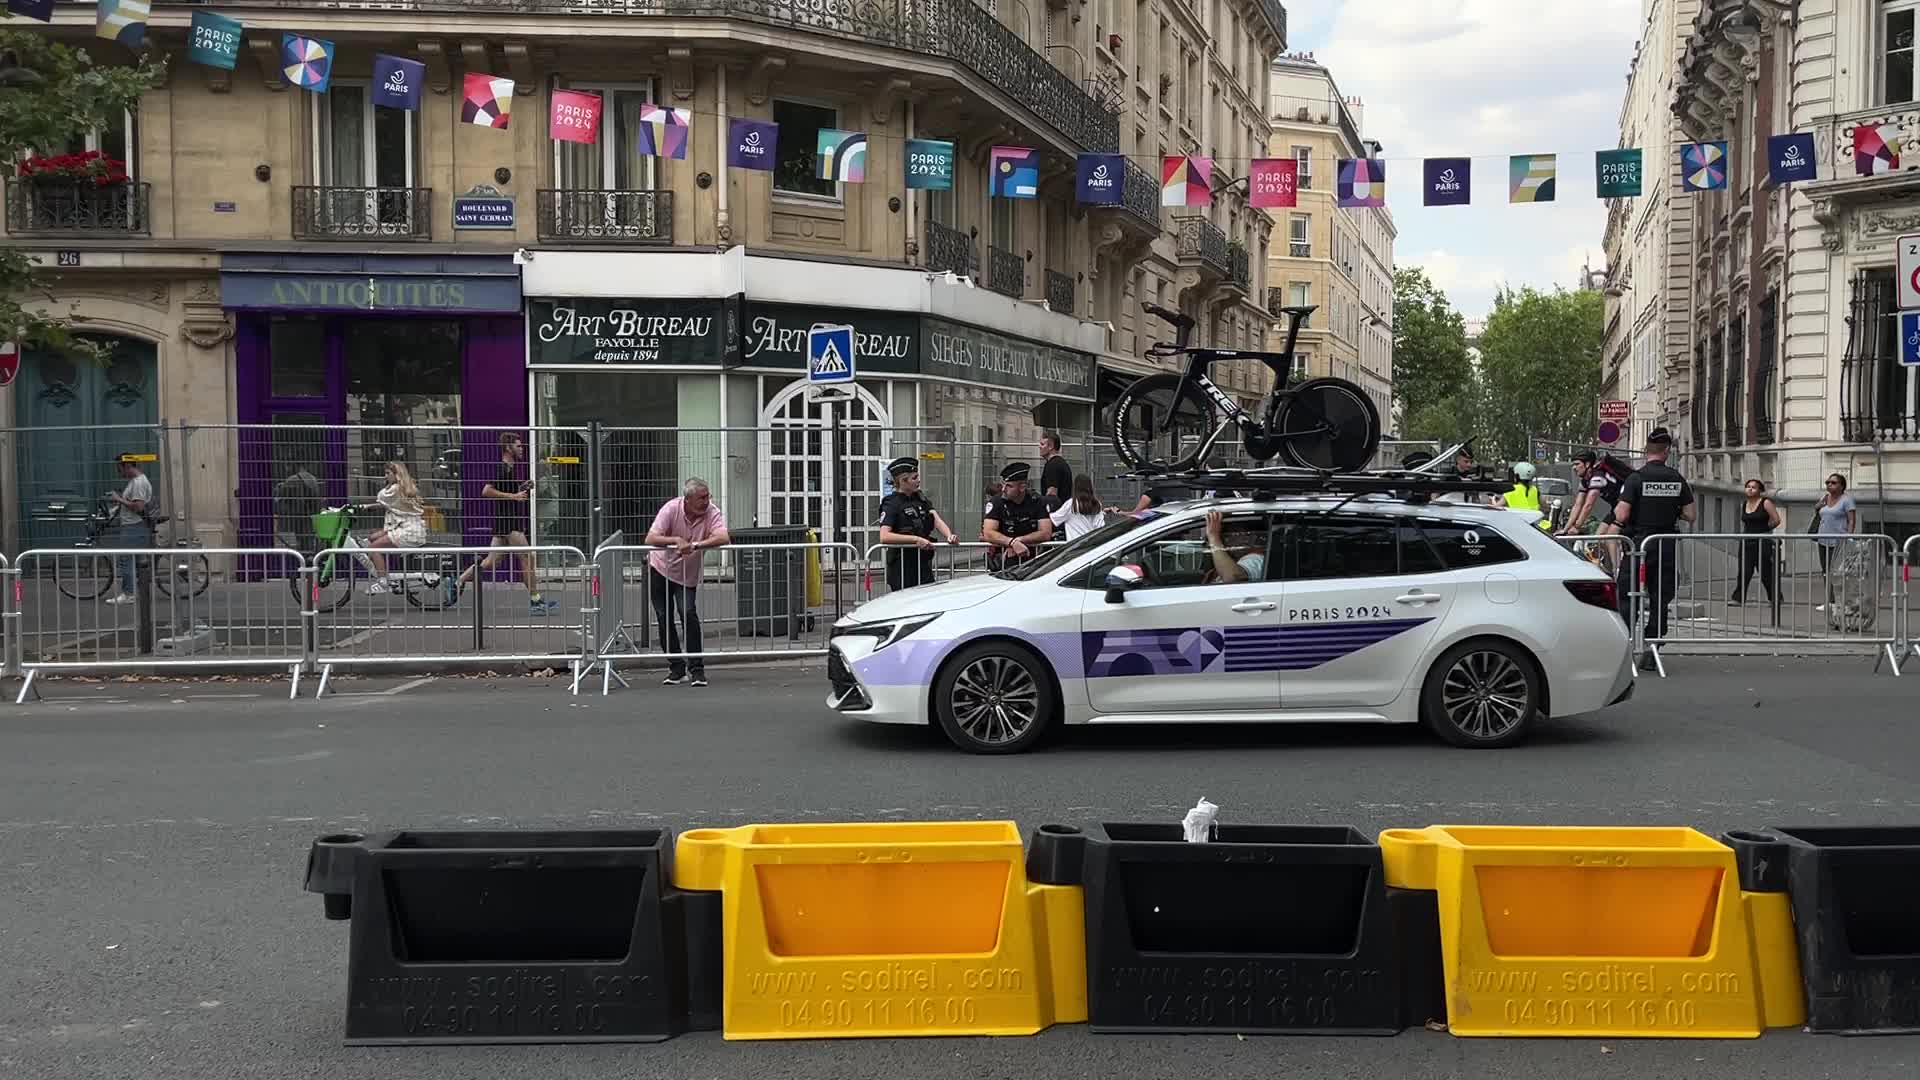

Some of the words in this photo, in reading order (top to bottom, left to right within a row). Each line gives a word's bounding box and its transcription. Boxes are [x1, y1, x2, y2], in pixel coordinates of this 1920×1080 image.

[196, 26, 233, 43] PARIS
[195, 38, 231, 54] 2024
[384, 82, 409, 94] PARIS
[557, 104, 593, 119] PARIS
[556, 116, 592, 130] 2024
[740, 144, 764, 155] PARIS
[911, 153, 945, 166] PARIS
[1780, 157, 1805, 169] PARIS
[911, 164, 945, 176] 2024
[1602, 162, 1636, 175] PARIS
[1088, 178, 1112, 188] PARIS
[1257, 173, 1292, 183] PARIS
[1602, 173, 1636, 185] 2024
[1257, 183, 1292, 194] 2024
[1435, 182, 1460, 191] PARIS
[456, 214, 477, 222] SAINT
[480, 214, 513, 222] GERMAIN
[60, 253, 77, 264] 26
[272, 279, 465, 309] ANTIQUITÉS
[595, 338, 659, 348] FAYOLLE
[855, 331, 910, 358] REAU
[594, 351, 629, 362] depuis
[633, 350, 658, 361] 1894
[980, 344, 1028, 377] BUREAUX
[1033, 350, 1089, 387] CLASSEMENT
[1289, 608, 1340, 621] PARIS
[1346, 606, 1393, 618] 2024
[780, 1000, 812, 1026] 04
[821, 1000, 852, 1025] 90
[863, 999, 894, 1025] 11
[905, 998, 936, 1024] 16
[945, 997, 976, 1024] 00
[1504, 1000, 1536, 1025] 04
[1585, 1000, 1614, 1025] 11
[1625, 1000, 1656, 1025] 16
[1665, 1000, 1695, 1025] 00
